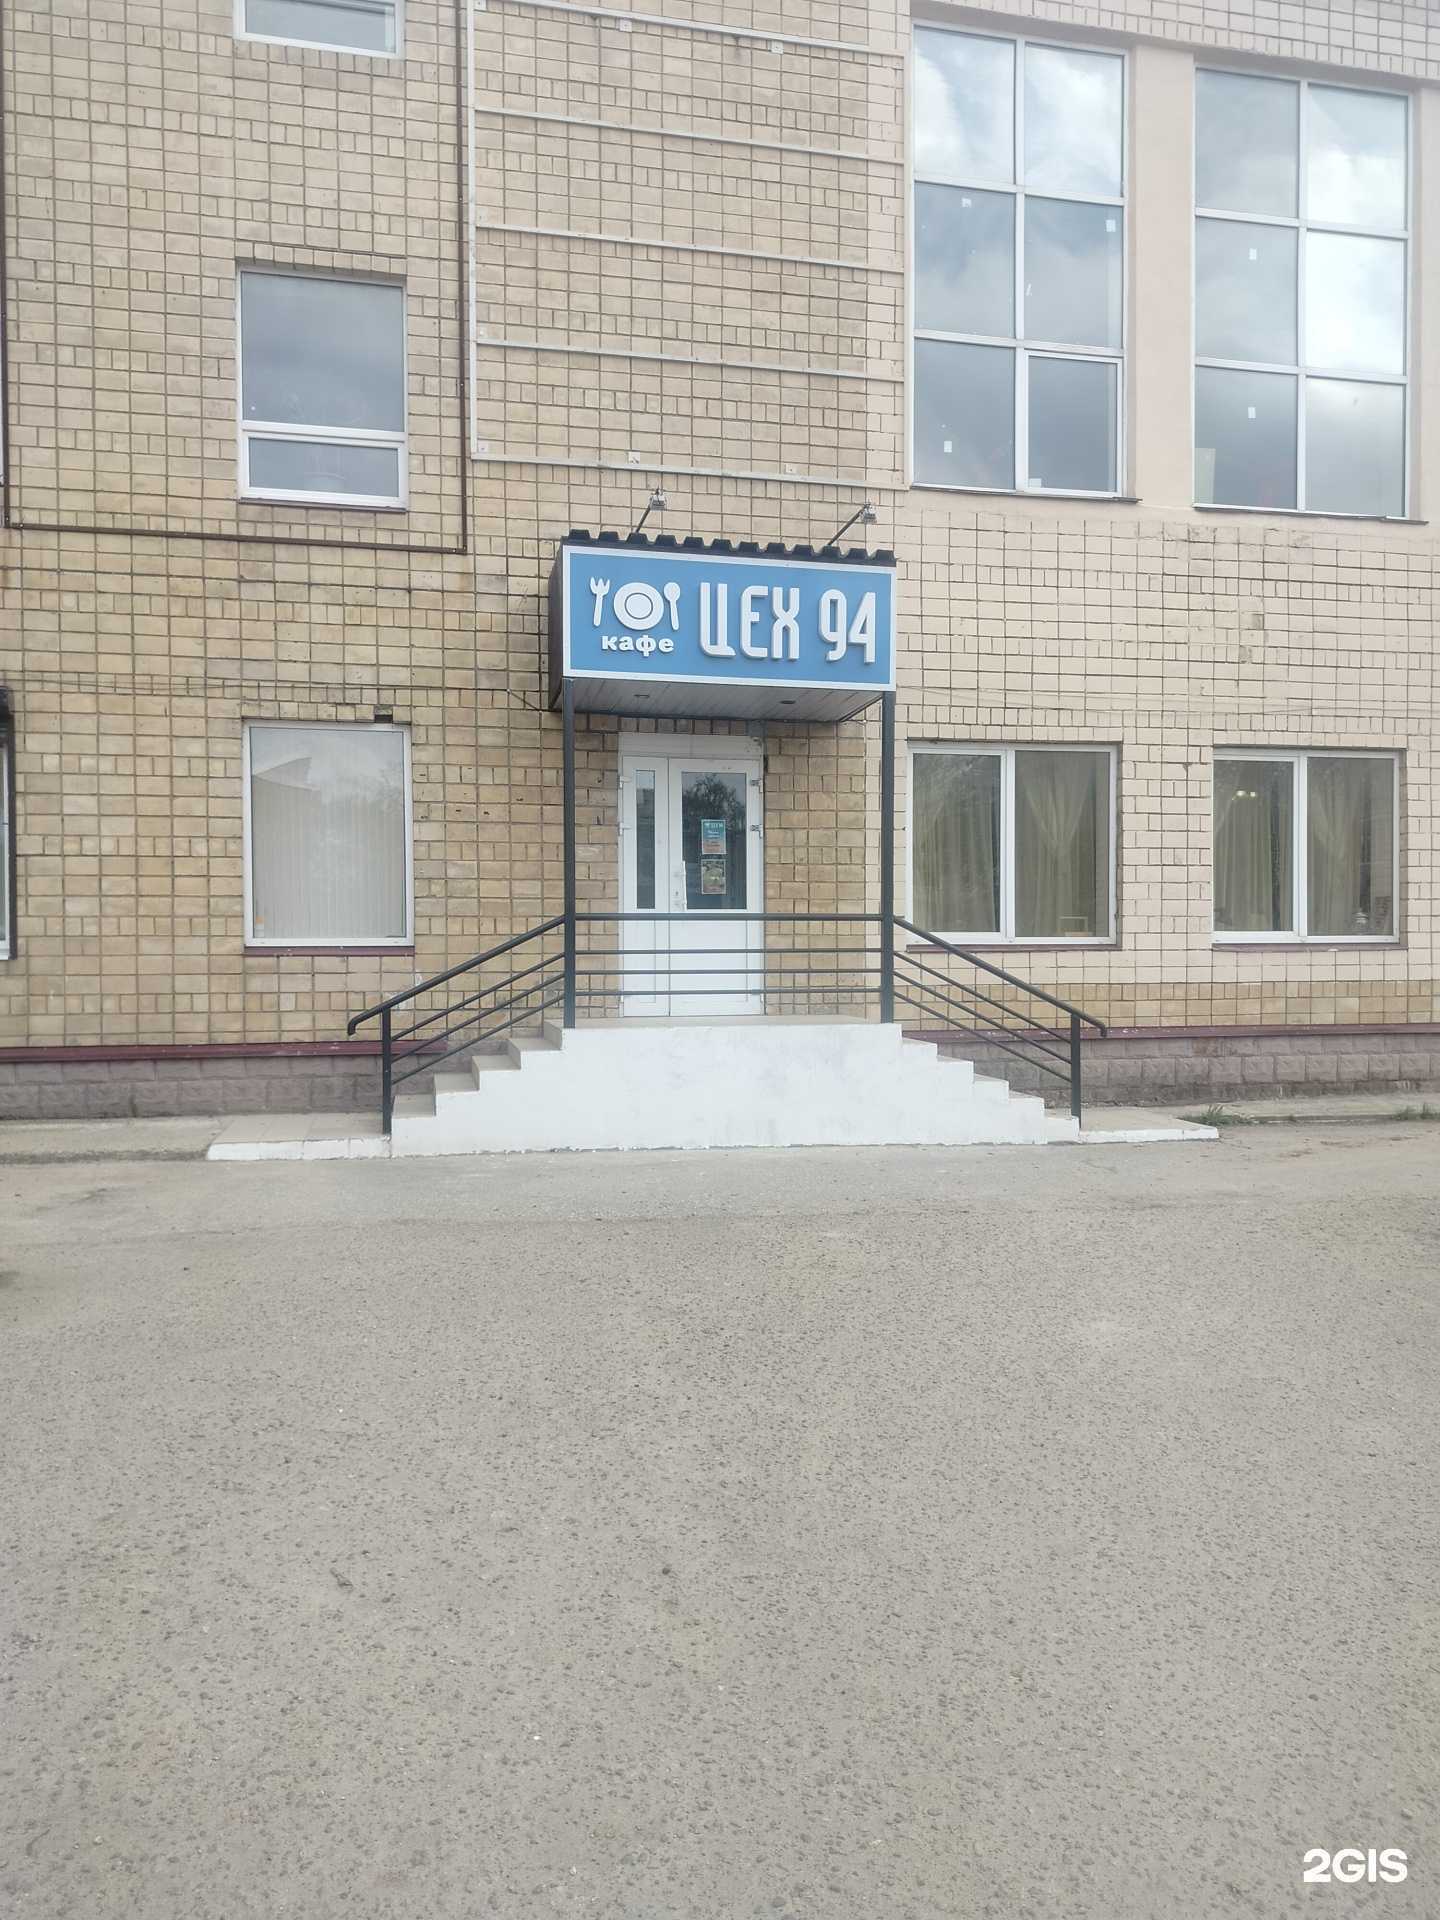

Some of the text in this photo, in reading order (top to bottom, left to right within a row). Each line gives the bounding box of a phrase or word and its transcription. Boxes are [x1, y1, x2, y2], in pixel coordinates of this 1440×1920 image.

[601, 635, 675, 657] кафе
[700, 582, 877, 664] ЦЕХ 94
